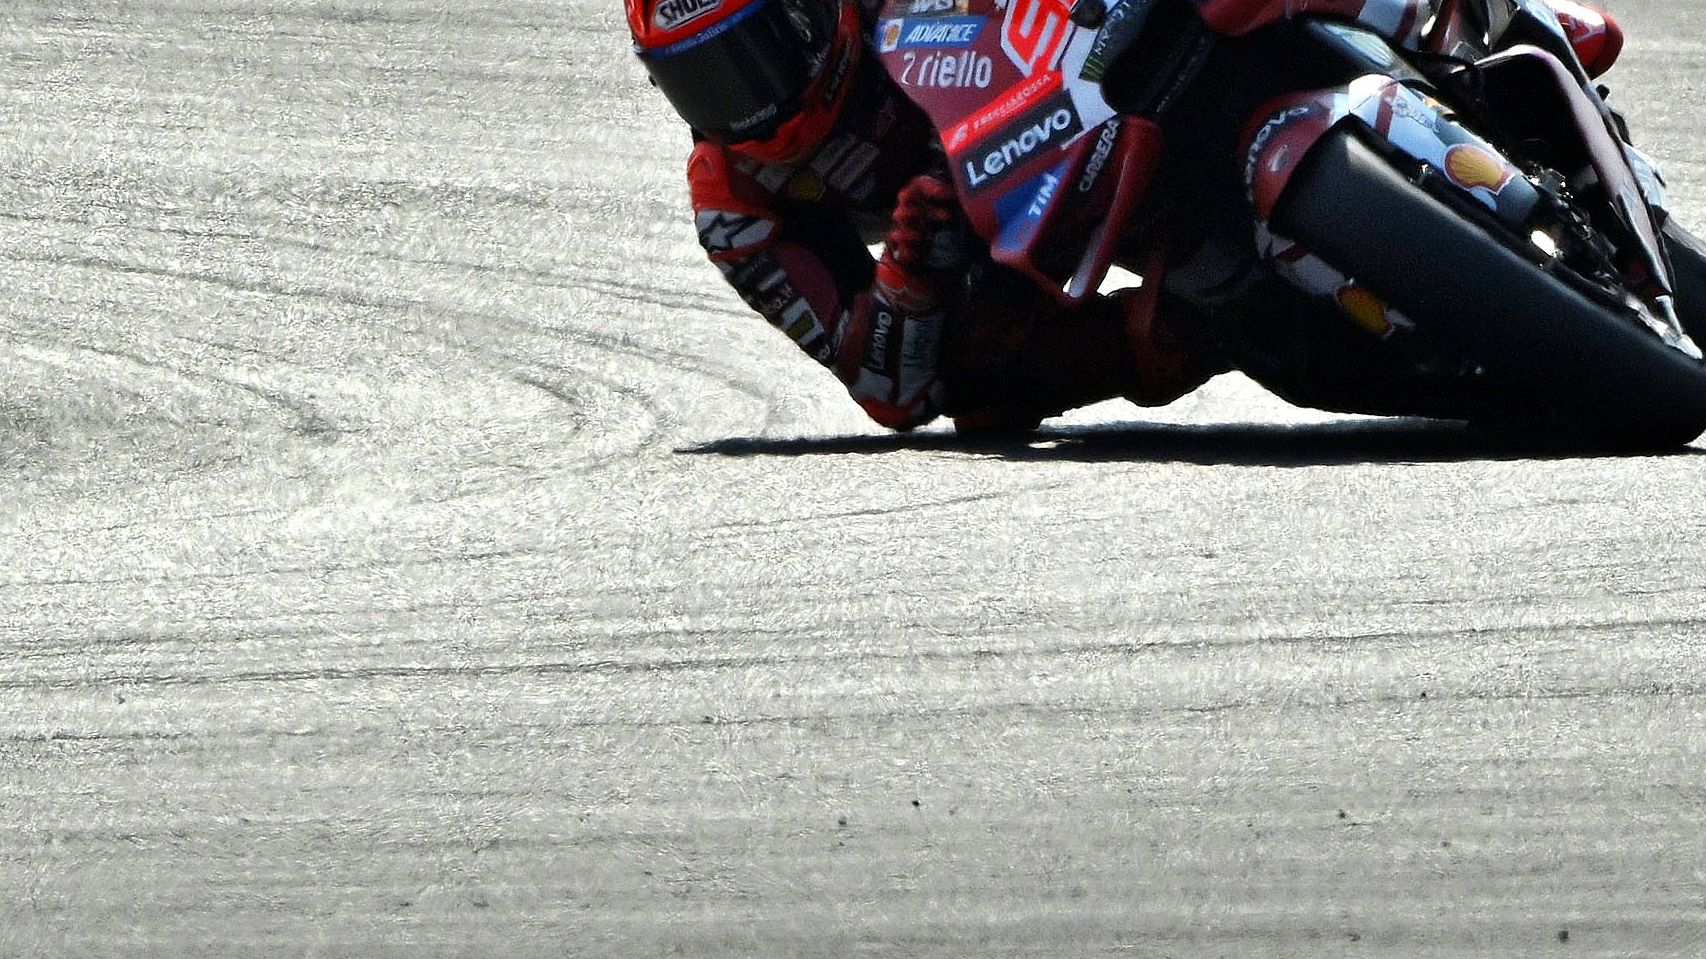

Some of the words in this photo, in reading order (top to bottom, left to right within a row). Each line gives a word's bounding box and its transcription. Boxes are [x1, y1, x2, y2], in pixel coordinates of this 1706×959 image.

[904, 19, 979, 44] ADVANCE
[916, 50, 994, 90] riello
[965, 108, 1072, 187] Lenovo
[1028, 172, 1060, 218] TIM
